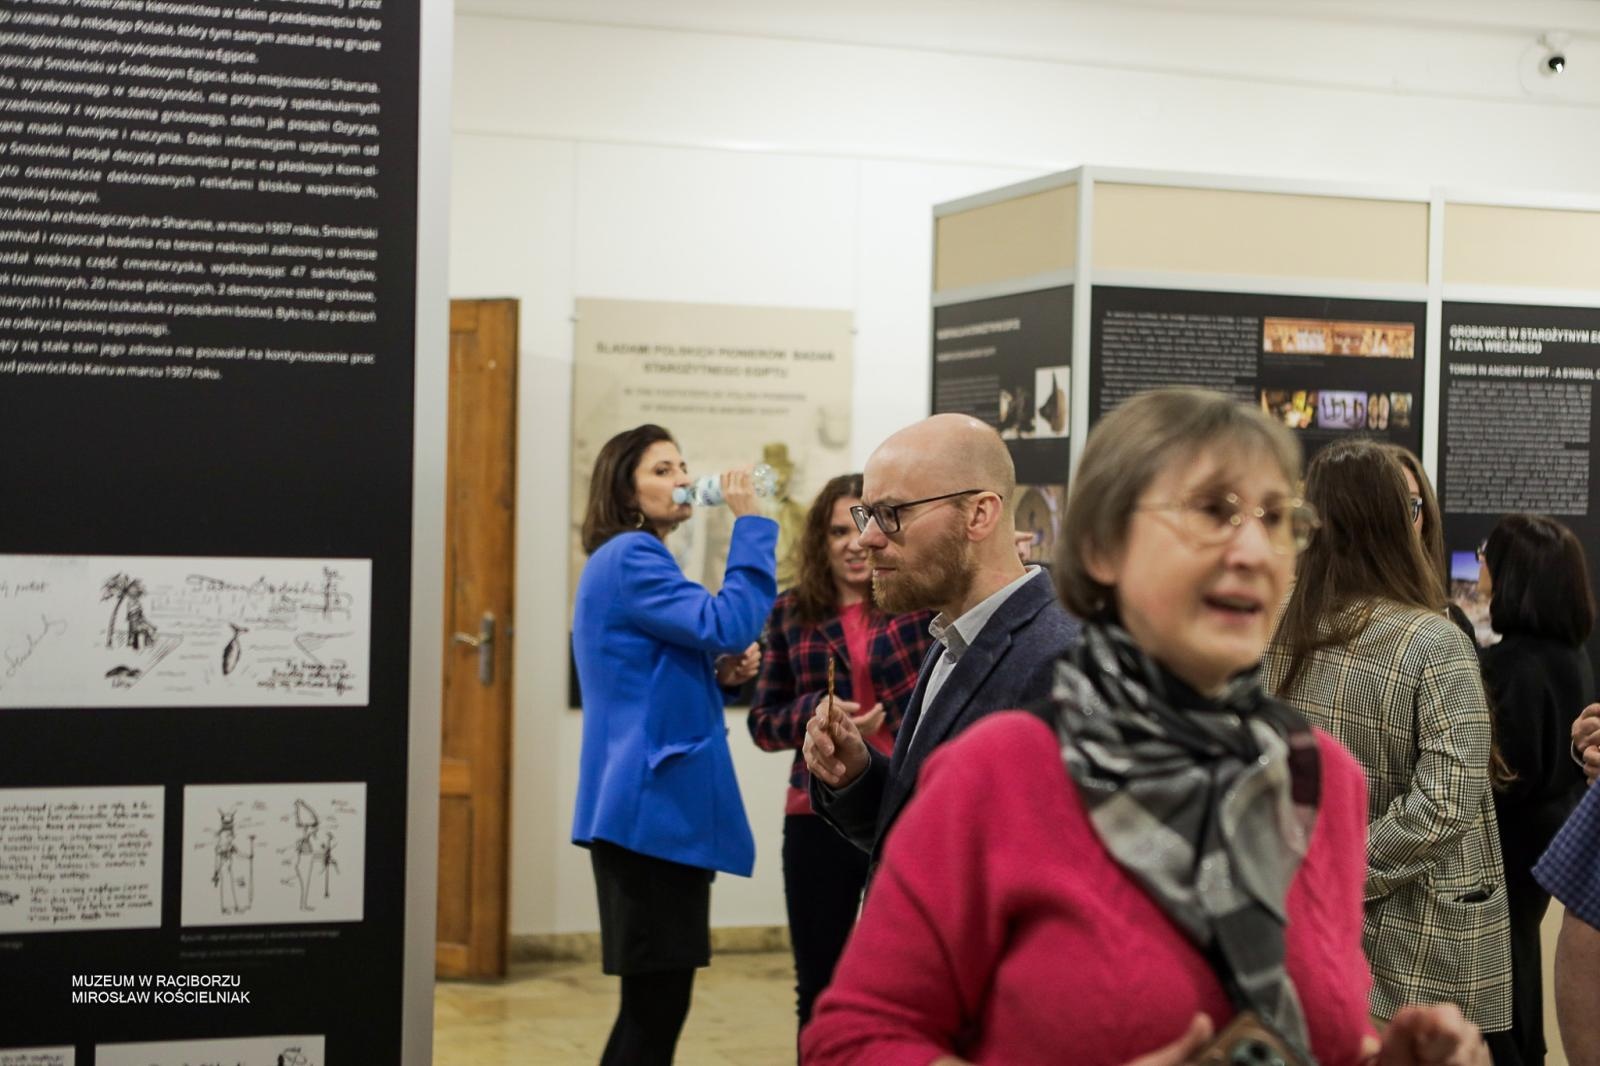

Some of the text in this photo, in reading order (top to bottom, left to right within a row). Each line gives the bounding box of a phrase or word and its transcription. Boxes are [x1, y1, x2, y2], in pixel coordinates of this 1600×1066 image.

[177, 23, 208, 40] który
[208, 27, 231, 41] tym
[232, 30, 275, 45] samym
[315, 36, 332, 49] się
[44, 56, 104, 73] Smoleński
[105, 63, 117, 74] w
[118, 60, 185, 81] Środkowym
[230, 71, 256, 84] koło
[112, 85, 124, 96] w
[208, 92, 227, 104] nie
[73, 104, 80, 115] z
[83, 105, 158, 120] wyposażenia
[230, 114, 265, 127] takich
[266, 117, 285, 131] jak
[27, 122, 63, 135] maski
[122, 128, 127, 139] i
[186, 131, 221, 147] Dzięki
[363, 144, 379, 156] od
[9, 141, 70, 157] Smoleński
[231, 158, 256, 170] prac
[259, 160, 275, 171] na
[24, 166, 101, 181] osiemnaście
[107, 170, 195, 188] dekorowanych
[42, 232, 46, 243] i
[49, 233, 105, 248] rozpoczął
[107, 234, 154, 249] badania
[155, 239, 171, 250] na
[173, 239, 214, 252] terenie
[324, 248, 336, 257] w
[34, 253, 80, 268] większą
[86, 256, 117, 269] część
[107, 279, 144, 291] masek
[217, 283, 225, 295] 2
[12, 317, 62, 332] odkrycie
[63, 319, 107, 335] polskiej
[1450, 324, 1507, 340] GROBOWCE
[1508, 326, 1519, 340] W
[1520, 327, 1590, 343] STAROŻYTNYM
[22, 340, 38, 353] się
[42, 340, 69, 352] stale
[72, 342, 98, 353] stan
[100, 344, 125, 357] jego
[175, 346, 194, 357] nie
[247, 349, 263, 360] na
[1454, 338, 1483, 353] ŻYCIA
[1484, 340, 1542, 354] WIECZNEGO
[1449, 363, 1595, 380] TOMBS IN ANCIENT EGYPT A SYMBOL
